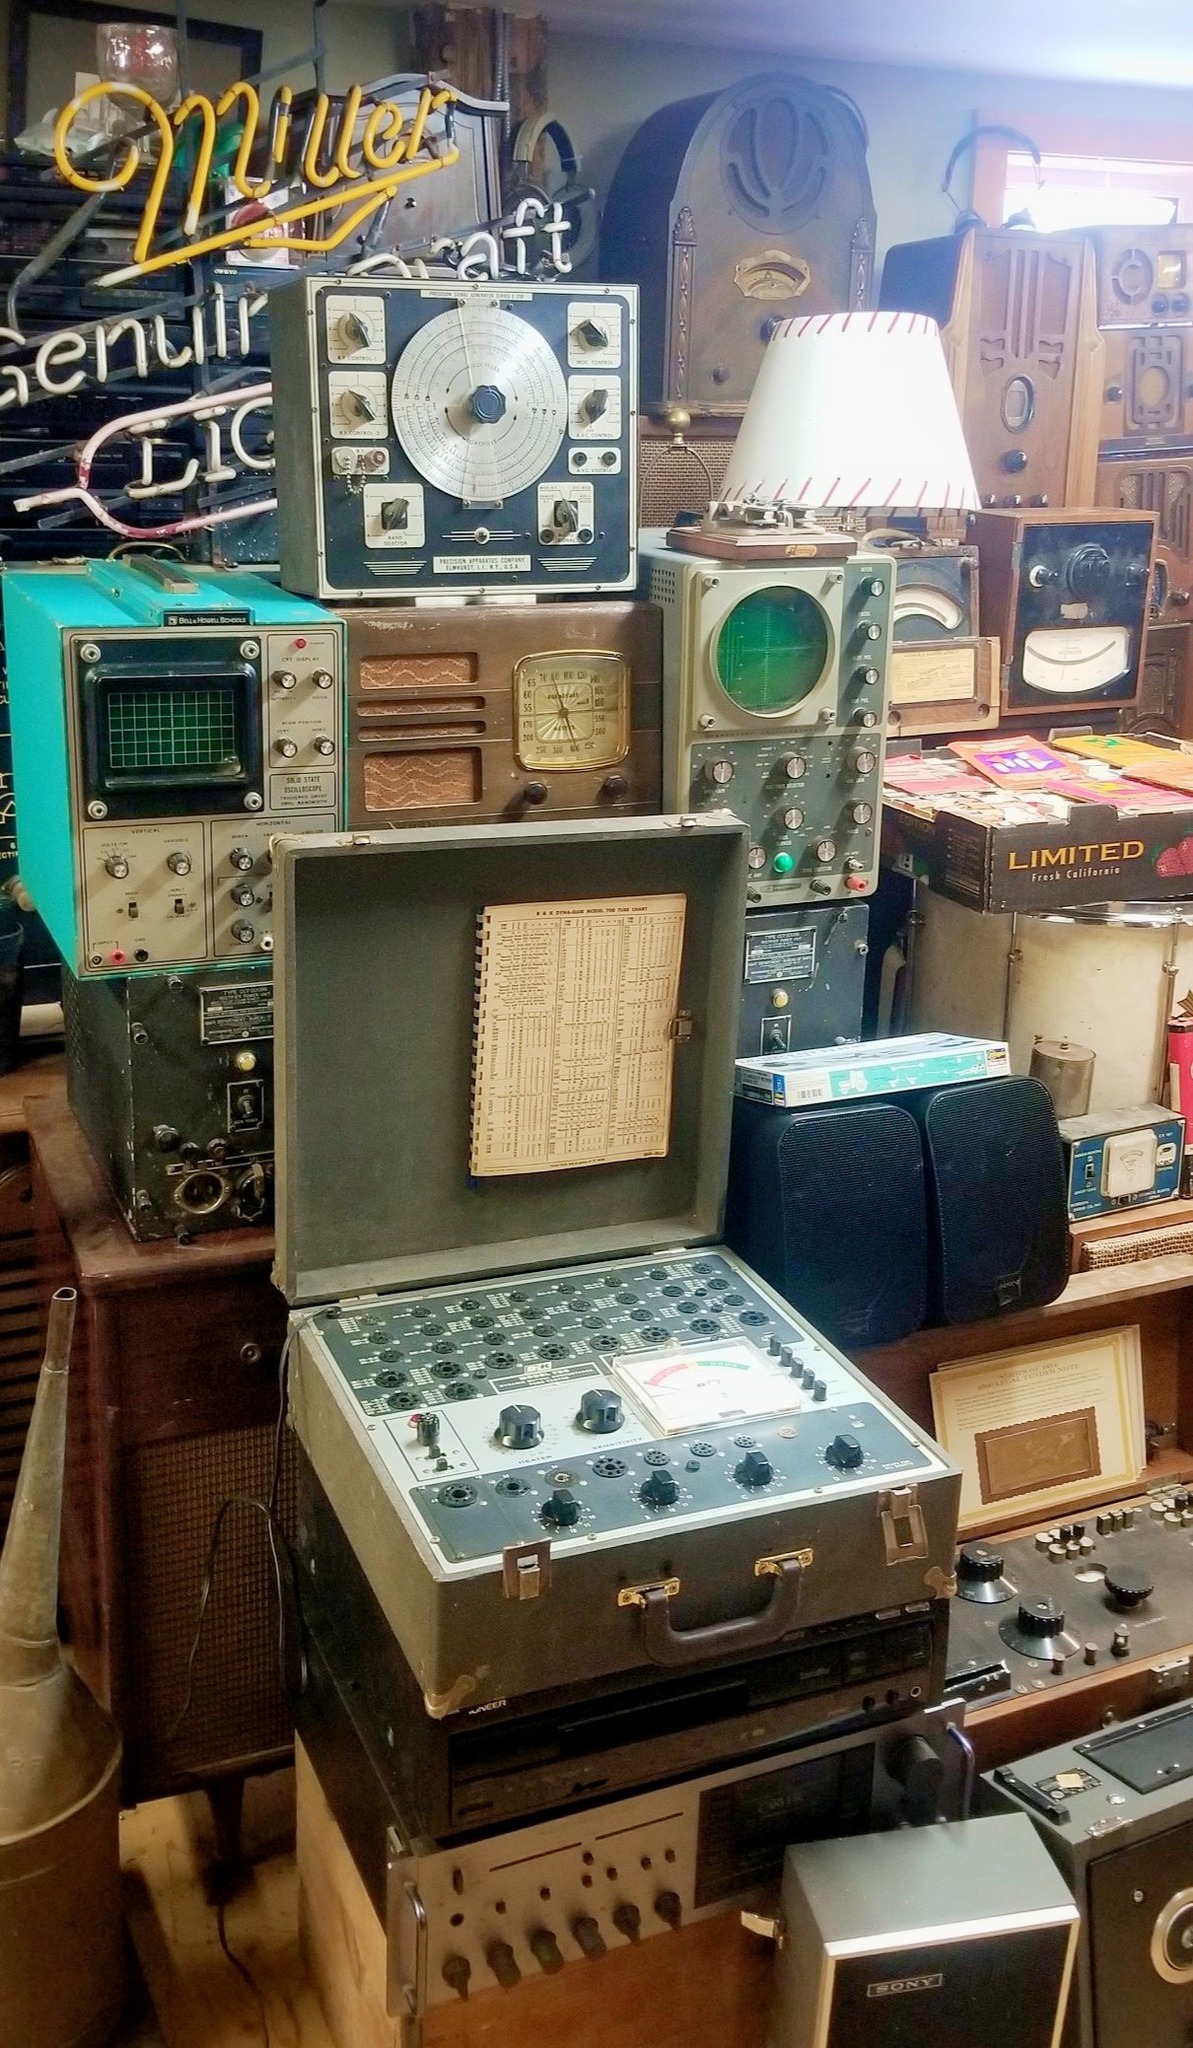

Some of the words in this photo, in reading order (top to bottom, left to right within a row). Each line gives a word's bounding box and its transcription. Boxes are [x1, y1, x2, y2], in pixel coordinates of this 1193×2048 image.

[54, 82, 458, 264] Miller
[524, 704, 532, 712] 55
[286, 776, 301, 784] SOLID
[284, 785, 322, 794] OSCILLOSCOPE
[1008, 840, 1145, 870] LIMITED
[1032, 870, 1061, 882] Fresh
[1066, 866, 1121, 879] California
[592, 1437, 643, 1450] SENSITIVITY
[518, 1456, 552, 1464] HEATER
[876, 1977, 933, 1994] SONY
